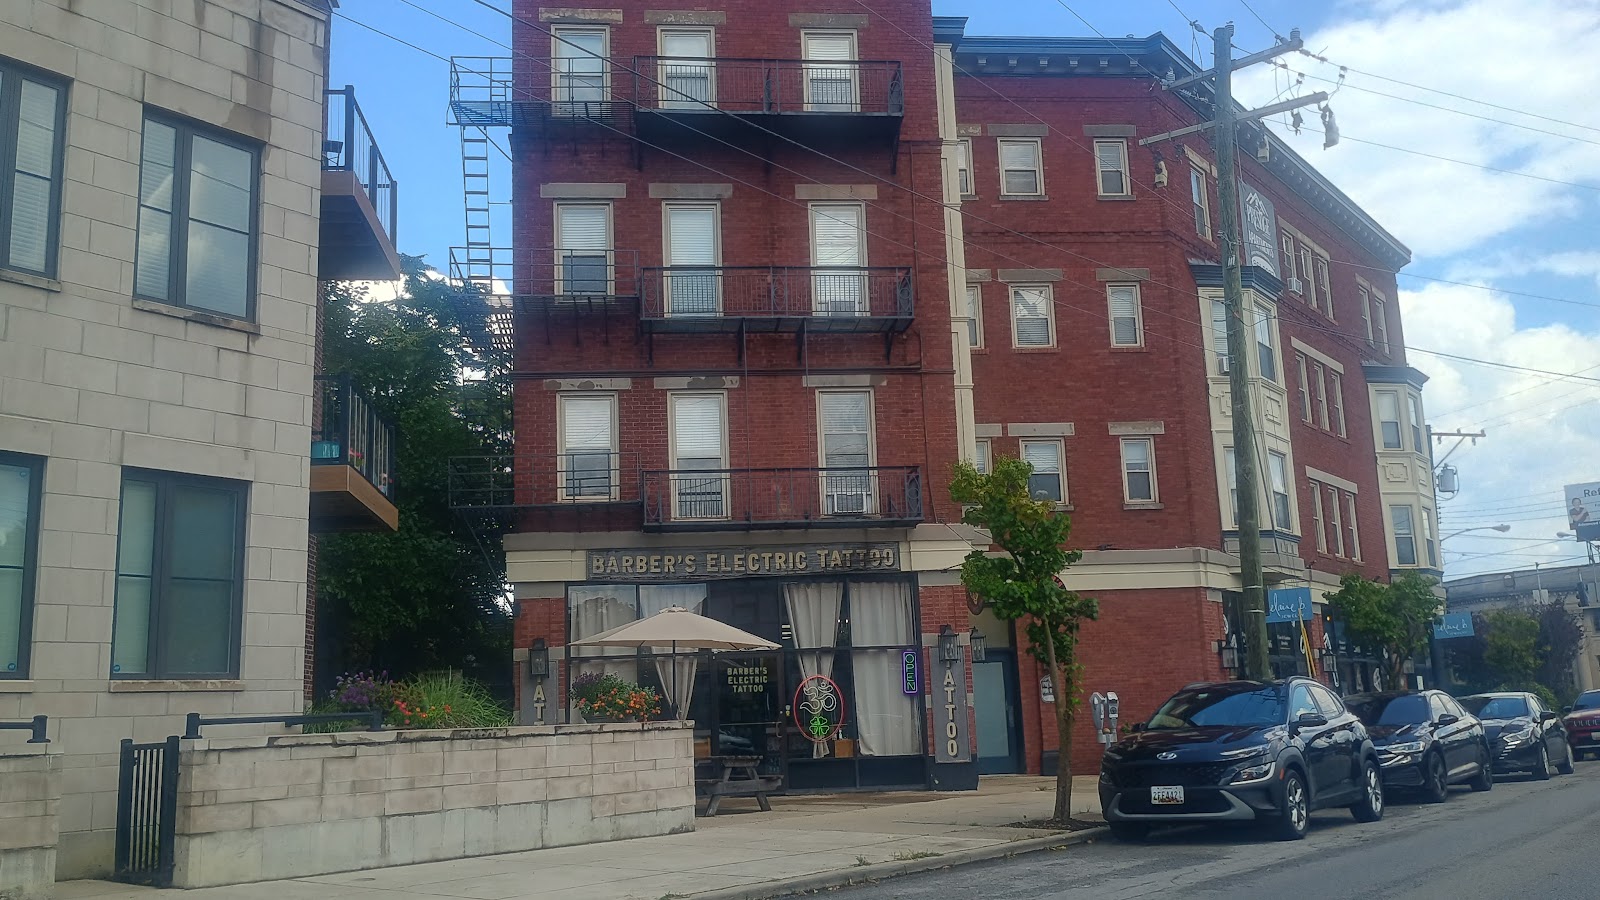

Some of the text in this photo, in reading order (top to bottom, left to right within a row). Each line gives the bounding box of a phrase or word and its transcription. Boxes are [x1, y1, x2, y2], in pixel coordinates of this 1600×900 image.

[592, 548, 894, 574] BARBER'S ELECTRIC TATTOO
[727, 667, 767, 675] BARBER'S
[905, 653, 915, 691] OPEN
[728, 676, 767, 684] ELECTRIC
[733, 684, 763, 693] TATTOO
